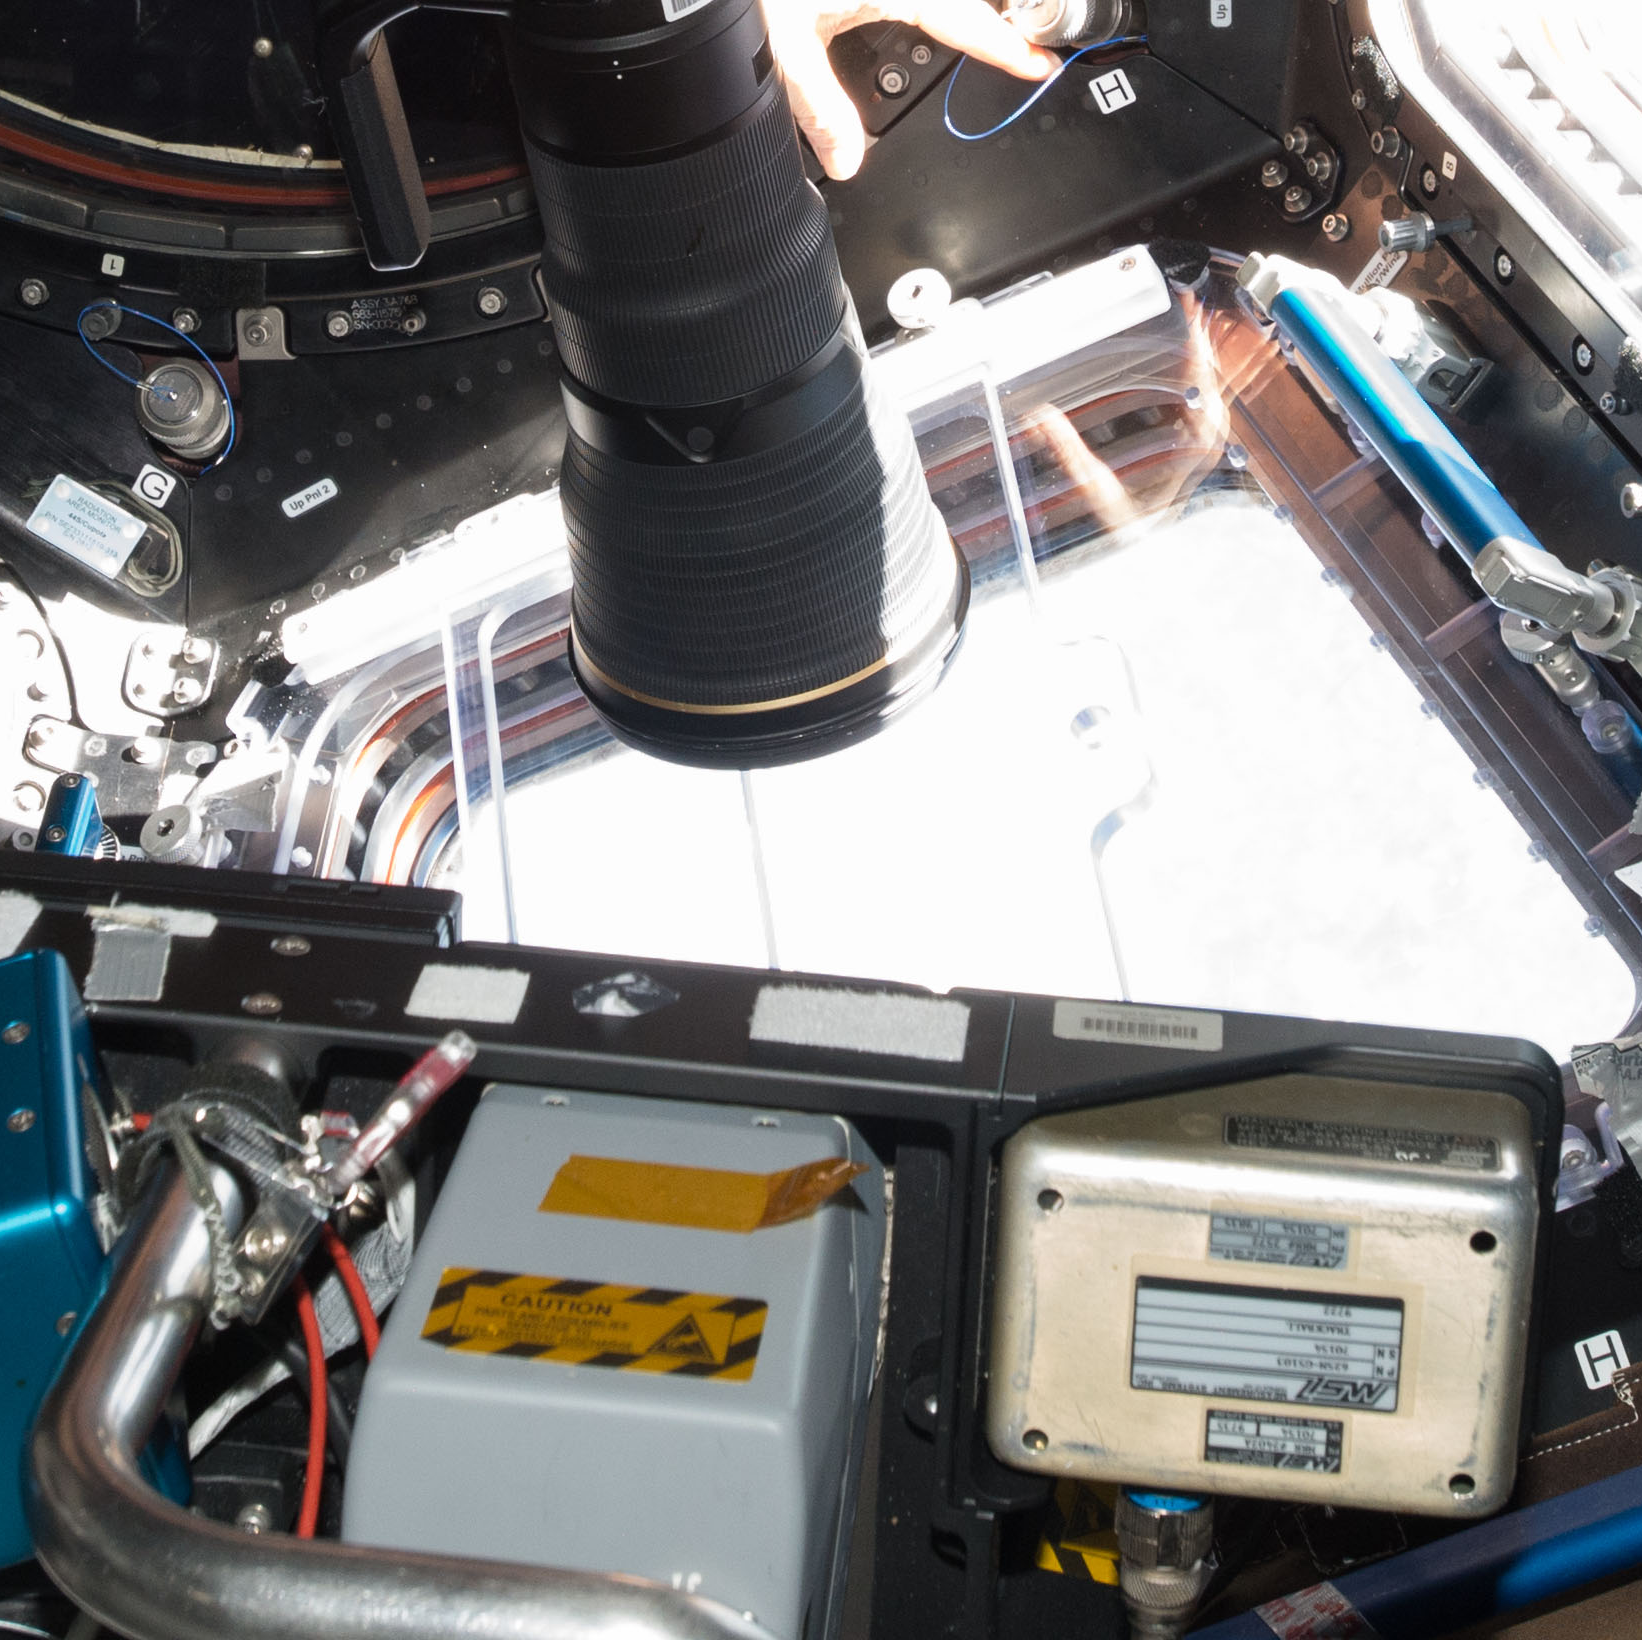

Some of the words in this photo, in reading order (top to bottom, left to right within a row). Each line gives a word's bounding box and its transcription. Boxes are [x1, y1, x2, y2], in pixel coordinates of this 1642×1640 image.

[1216, 4, 1229, 20] Up
[1096, 73, 1129, 108] H
[1445, 160, 1455, 172] 8
[107, 259, 118, 272] 1
[1374, 252, 1402, 286] 1/Win2
[140, 472, 169, 501] G
[289, 499, 306, 511] Up
[305, 488, 323, 503] Pnl
[323, 484, 331, 494] 2
[66, 498, 87, 514] AREA
[86, 510, 122, 534] MONITOR
[77, 496, 118, 524] RADIATION
[500, 1292, 613, 1317] CAUTION
[1285, 1321, 1351, 1336] TRACKBALL
[1583, 1335, 1622, 1382] H
[1212, 1386, 1288, 1400] MEASUREMENT
